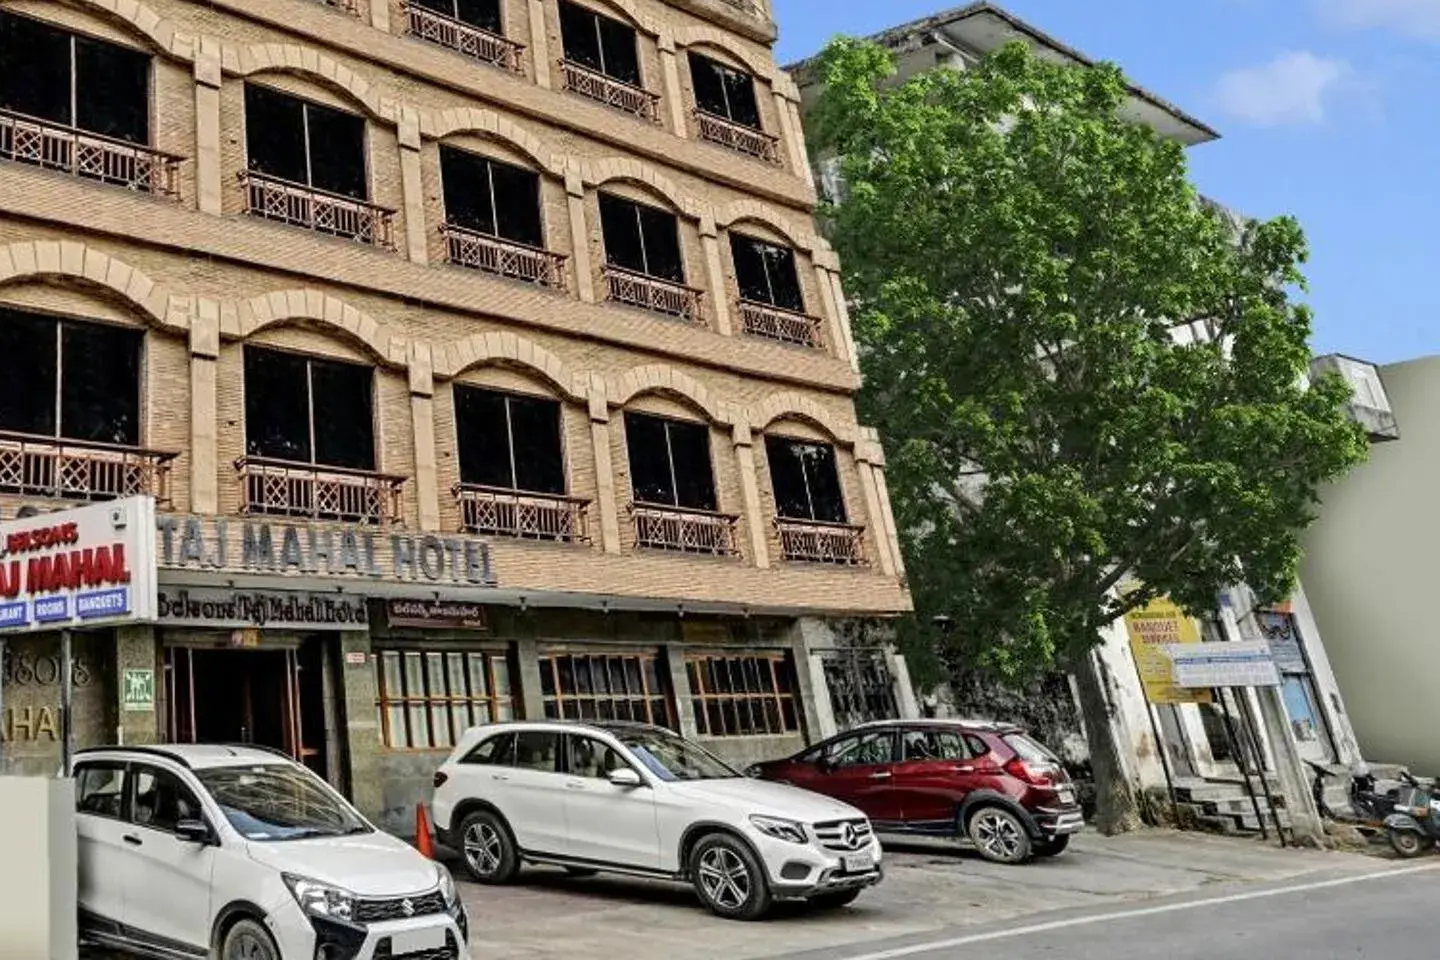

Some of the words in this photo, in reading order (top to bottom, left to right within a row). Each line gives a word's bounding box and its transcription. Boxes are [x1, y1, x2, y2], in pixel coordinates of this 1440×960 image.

[26, 543, 131, 596] MAHAL
[156, 516, 228, 567] TAJ
[243, 521, 382, 578] MAHAL
[389, 533, 498, 588] HOTEL
[36, 600, 64, 617] ROOMS
[78, 593, 123, 612] BANQUETS
[15, 653, 91, 687] SOS
